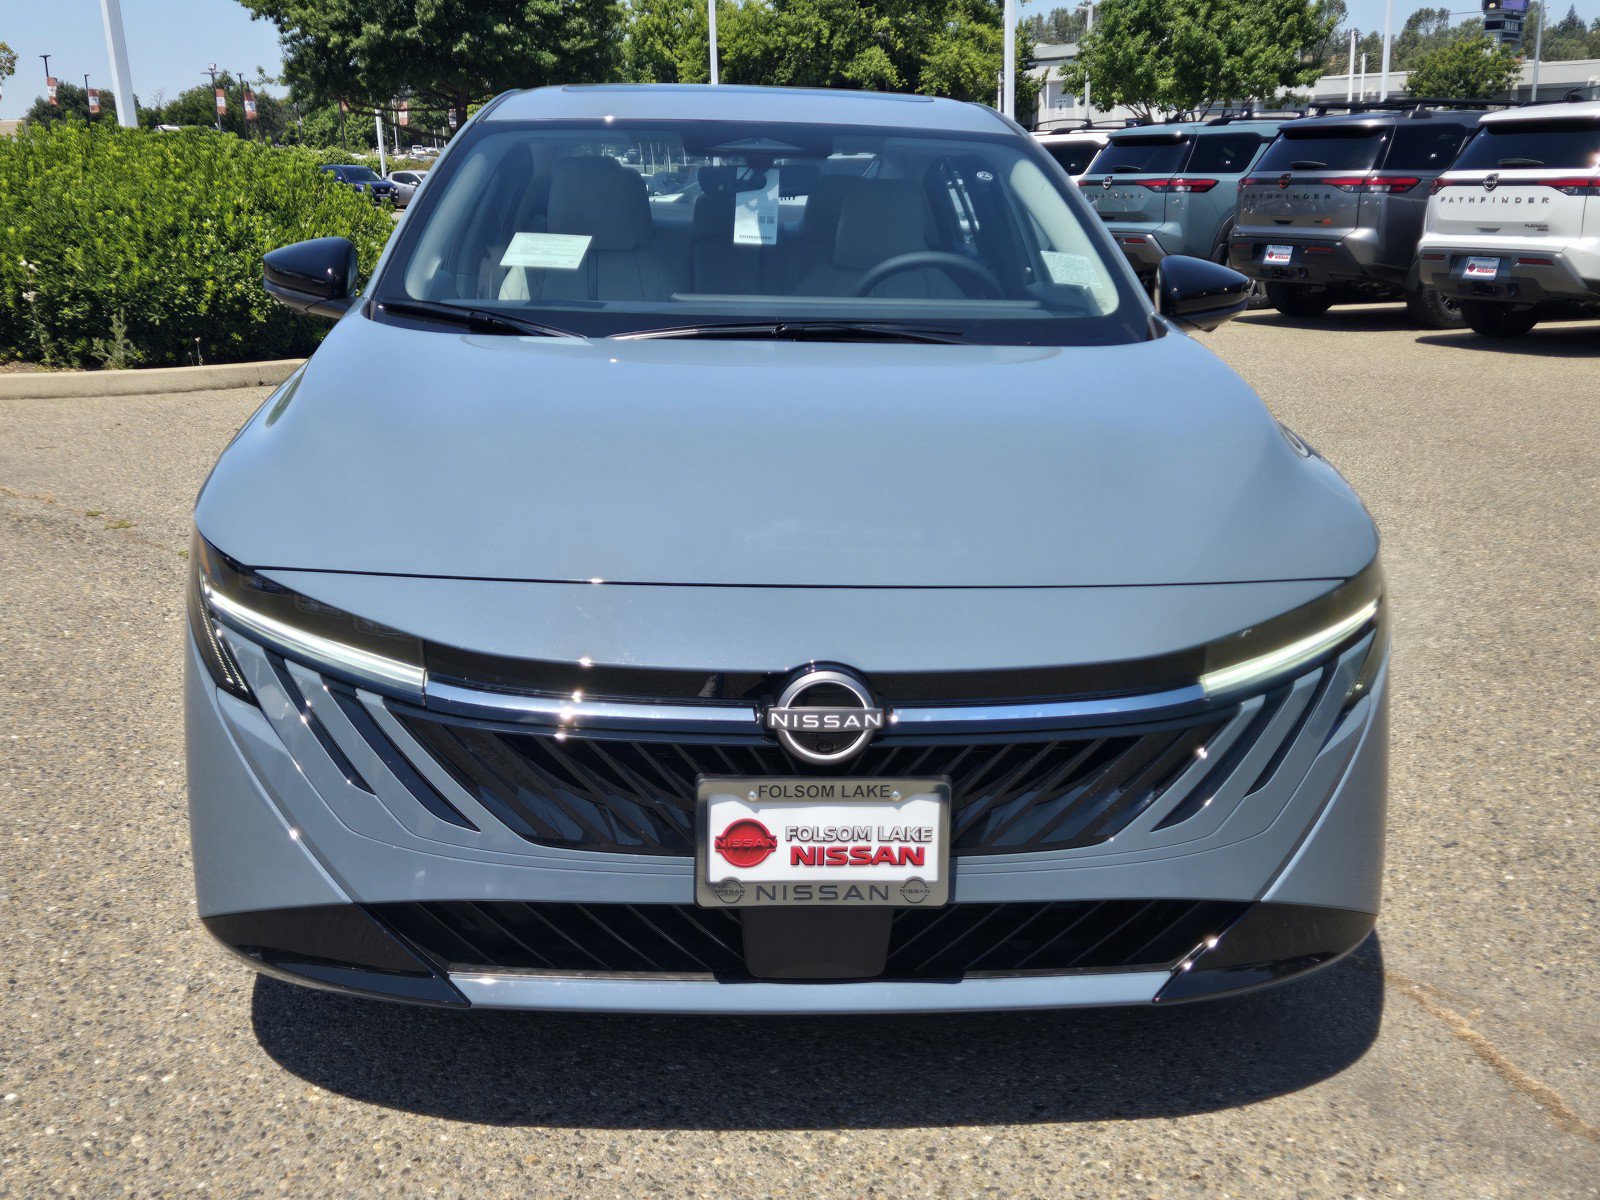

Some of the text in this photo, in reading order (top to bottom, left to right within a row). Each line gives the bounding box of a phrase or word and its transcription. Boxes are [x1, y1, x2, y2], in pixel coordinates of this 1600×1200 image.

[1244, 192, 1333, 200] PATHFINDER
[1440, 196, 1550, 204] PATHFINDER
[770, 712, 882, 729] NISSAN
[757, 784, 891, 799] FOLSOM LAKE
[785, 825, 933, 843] FOLSOM LAKE
[714, 838, 778, 848] NISSAN
[790, 845, 926, 866] NISSAN
[713, 887, 746, 895] NISSAN
[755, 884, 889, 901] NISSAN
[900, 887, 931, 895] NISSAN
